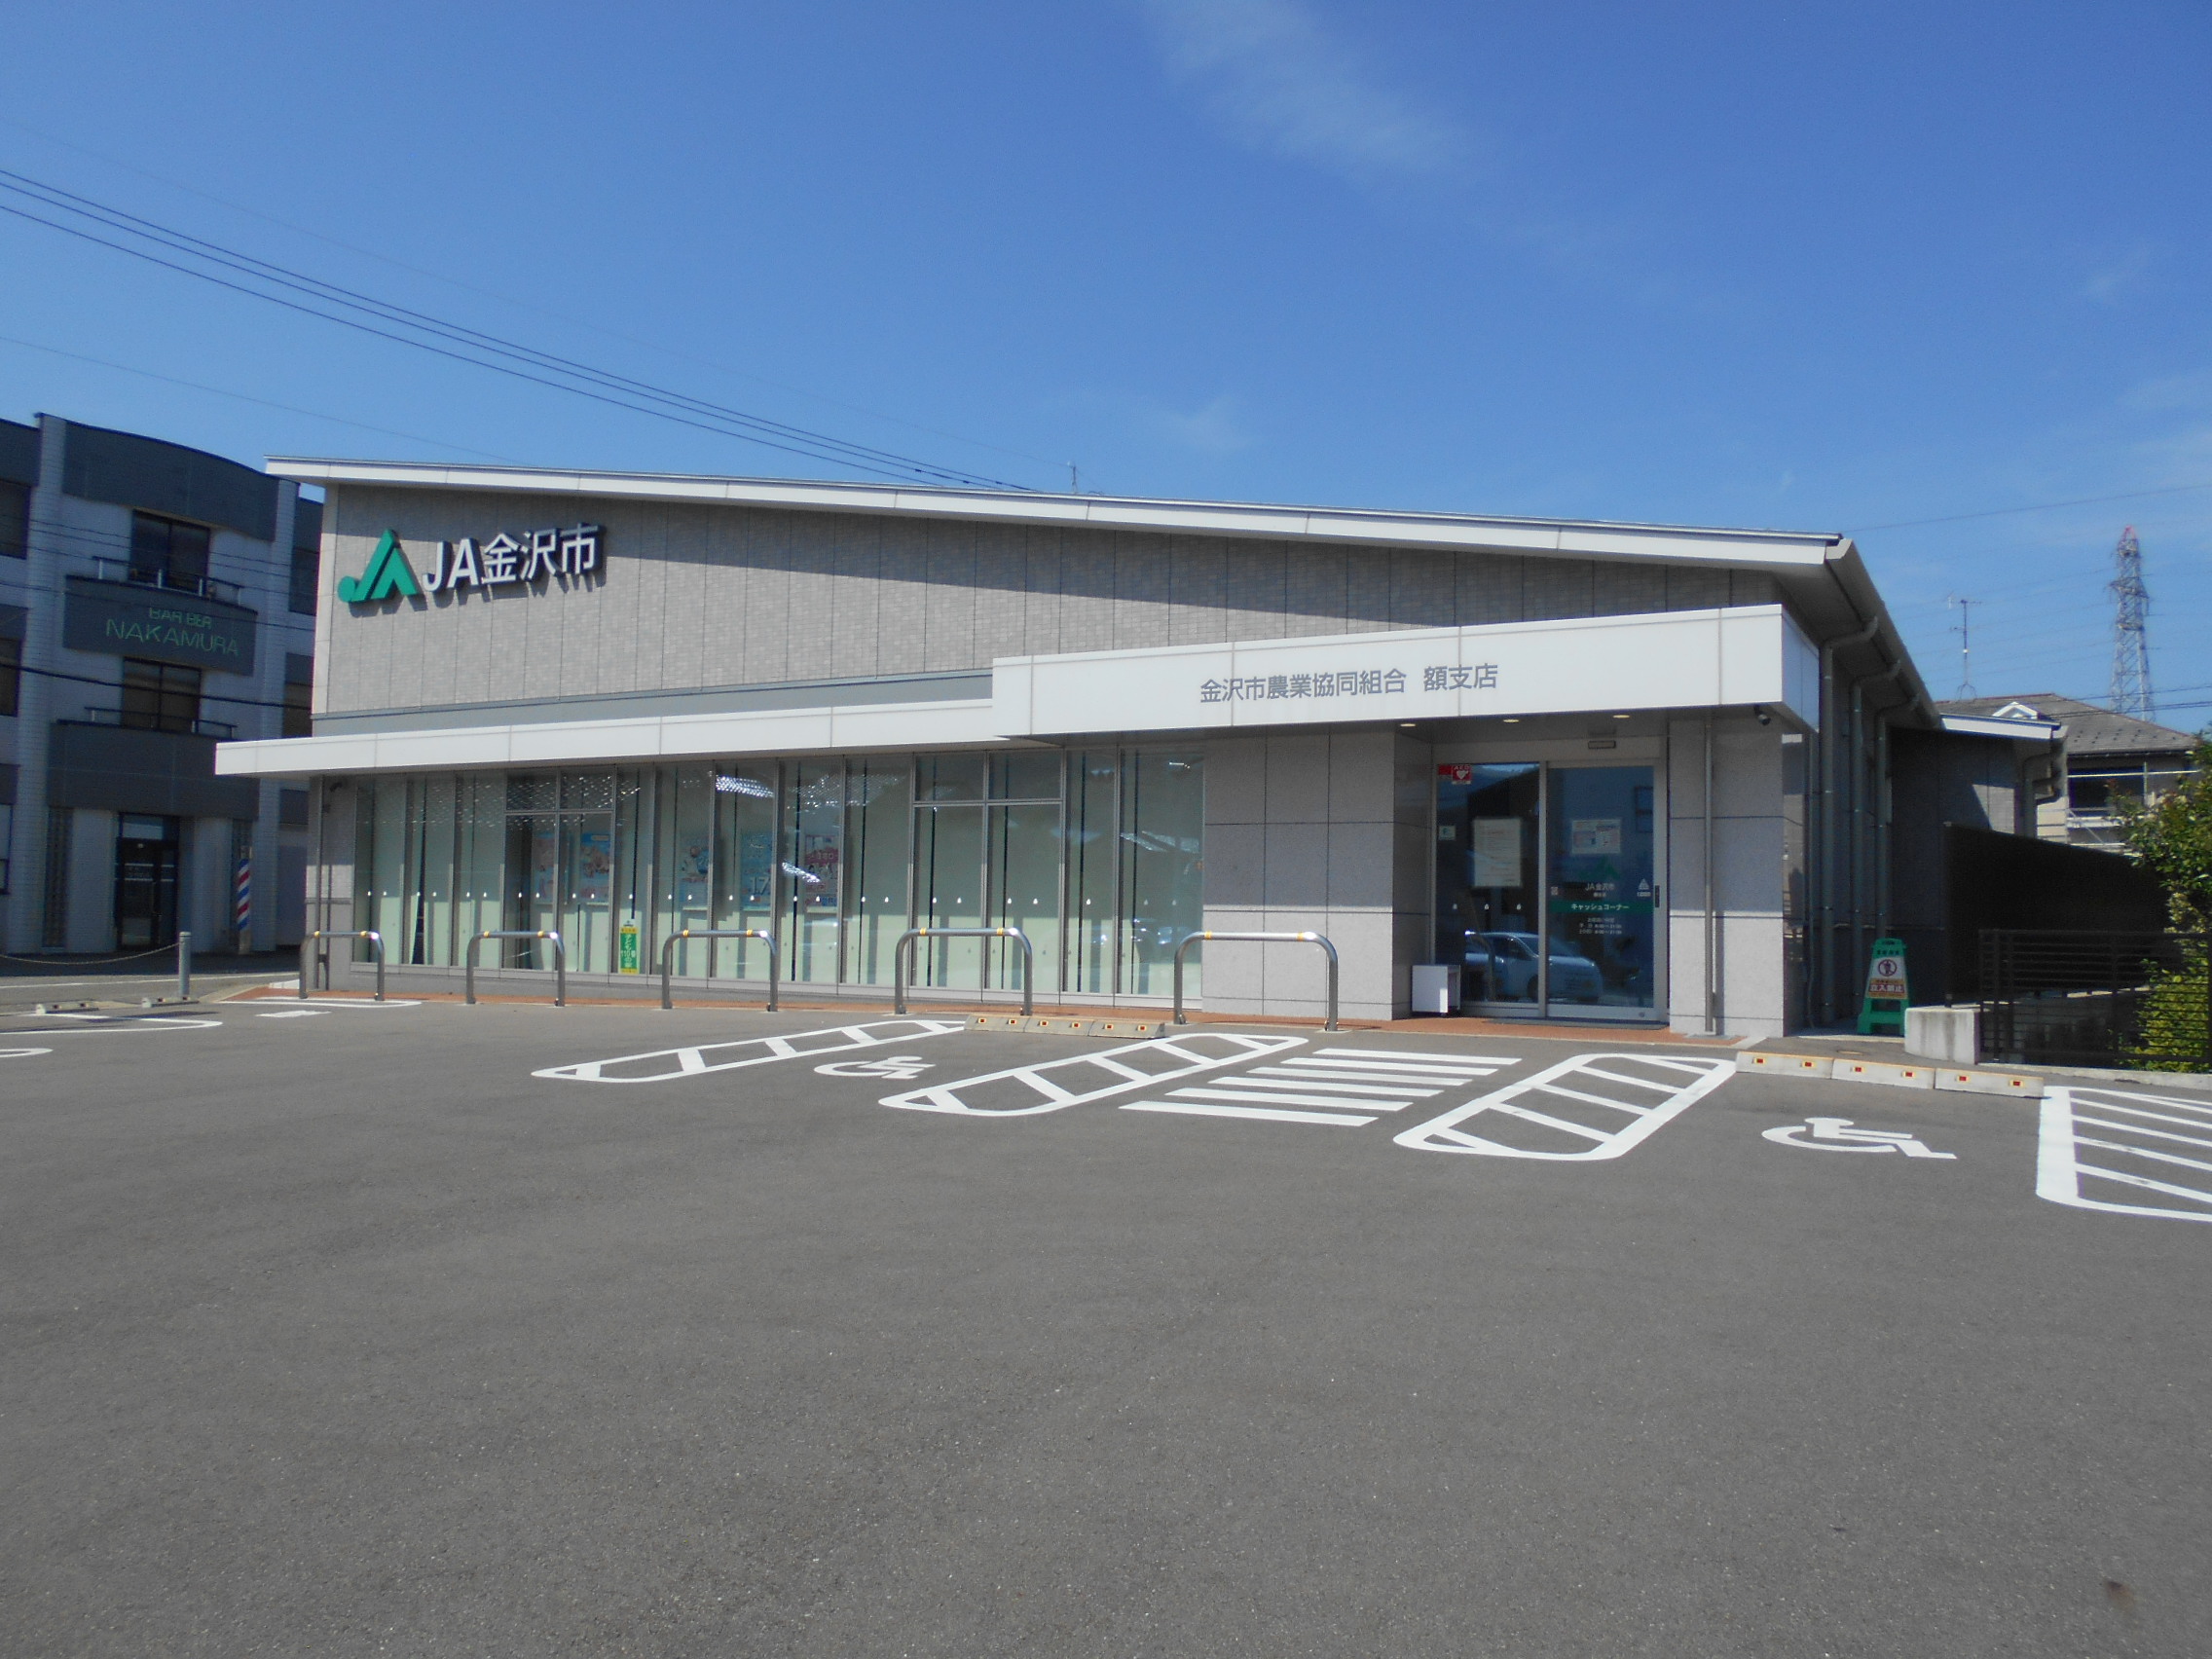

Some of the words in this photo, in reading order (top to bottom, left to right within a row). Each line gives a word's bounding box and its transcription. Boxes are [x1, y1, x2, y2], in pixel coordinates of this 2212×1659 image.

[422, 522, 600, 593] JA金沢市
[106, 619, 239, 656] NAKAMURA
[1200, 668, 1407, 703] 金沢市農業協同組合
[1423, 663, 1498, 692] 額支店
[1570, 903, 1630, 911] キャッシュコーナー
